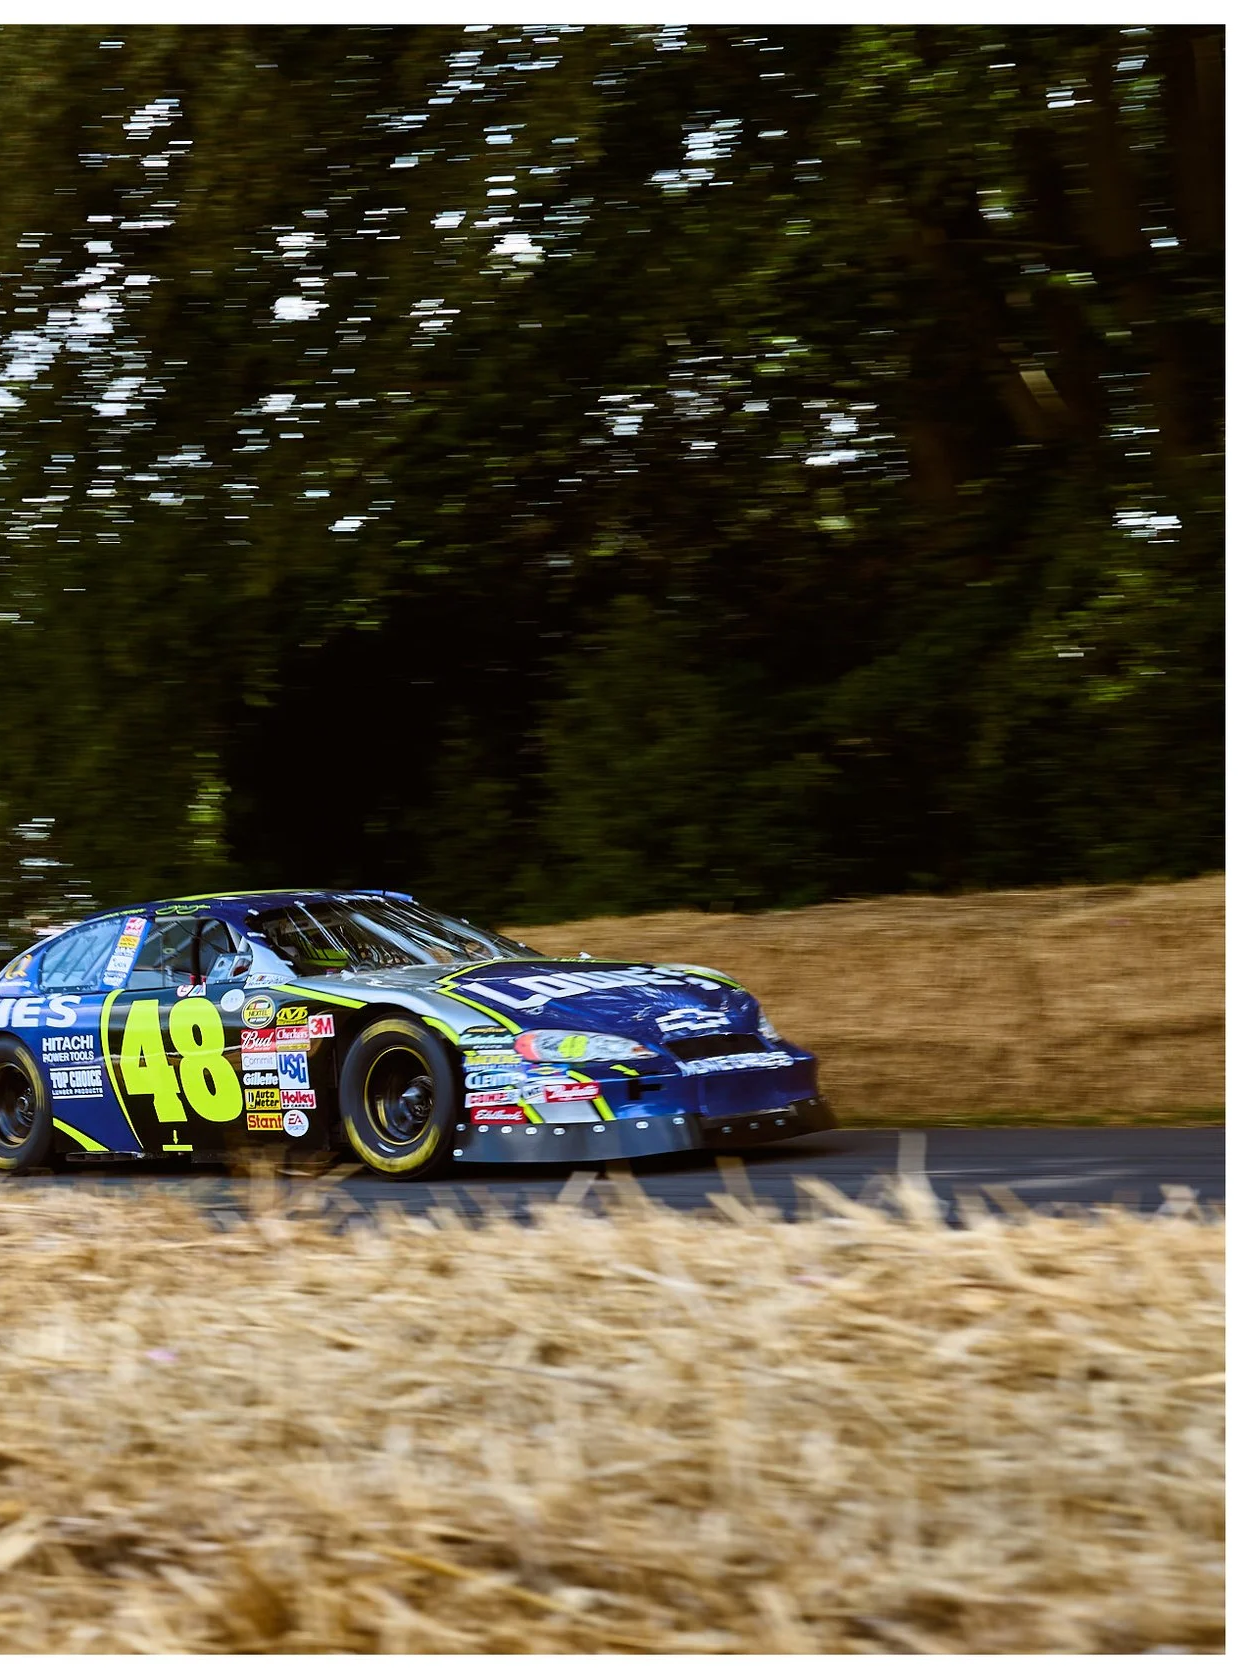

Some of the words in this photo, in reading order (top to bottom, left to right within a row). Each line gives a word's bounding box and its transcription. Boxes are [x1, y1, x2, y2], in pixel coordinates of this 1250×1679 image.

[310, 1018, 333, 1036] 3M
[42, 1035, 94, 1052] HITACHI
[241, 1030, 275, 1050] Bud
[42, 1052, 70, 1063] POWER
[70, 1050, 95, 1061] TOOLS
[120, 997, 244, 1122] 48
[279, 1053, 307, 1083] USG
[50, 1071, 69, 1088] TOP
[69, 1070, 102, 1087] CHOICE
[243, 1072, 279, 1086] Gillette
[254, 1098, 279, 1107] Meter
[255, 1091, 275, 1099] Auto
[281, 1091, 314, 1107] Holley
[248, 1115, 283, 1129] Stant
[288, 1113, 304, 1125] EA
